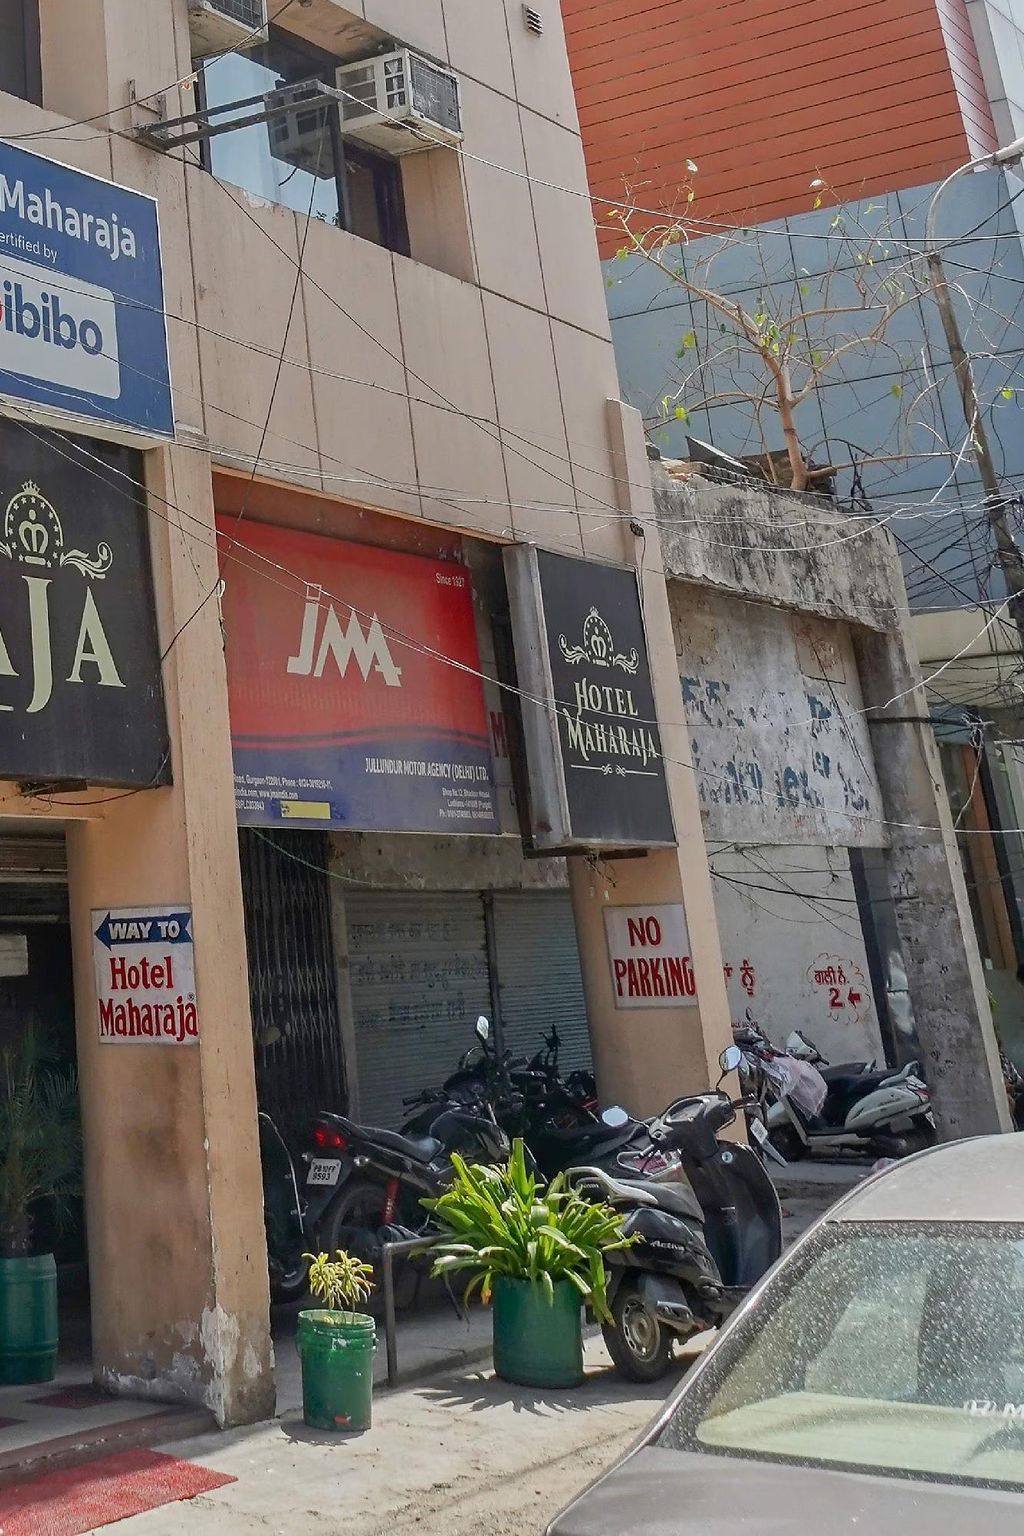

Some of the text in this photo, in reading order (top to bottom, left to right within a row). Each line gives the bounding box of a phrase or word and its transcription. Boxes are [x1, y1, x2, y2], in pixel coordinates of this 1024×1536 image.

[41, 243, 58, 264] by
[435, 572, 451, 586] Since
[573, 677, 638, 717] HOTEL
[563, 707, 659, 767] MAHARAJA
[365, 757, 489, 782] JULLUNDUR MOTOR AGENCY (DELHI) LTD.
[108, 920, 180, 941] WAY TO
[627, 916, 661, 947] NO
[109, 955, 175, 991] Hotel
[613, 956, 697, 997] PARKING
[829, 987, 844, 1008] 2
[98, 995, 199, 1042] Maharaja
